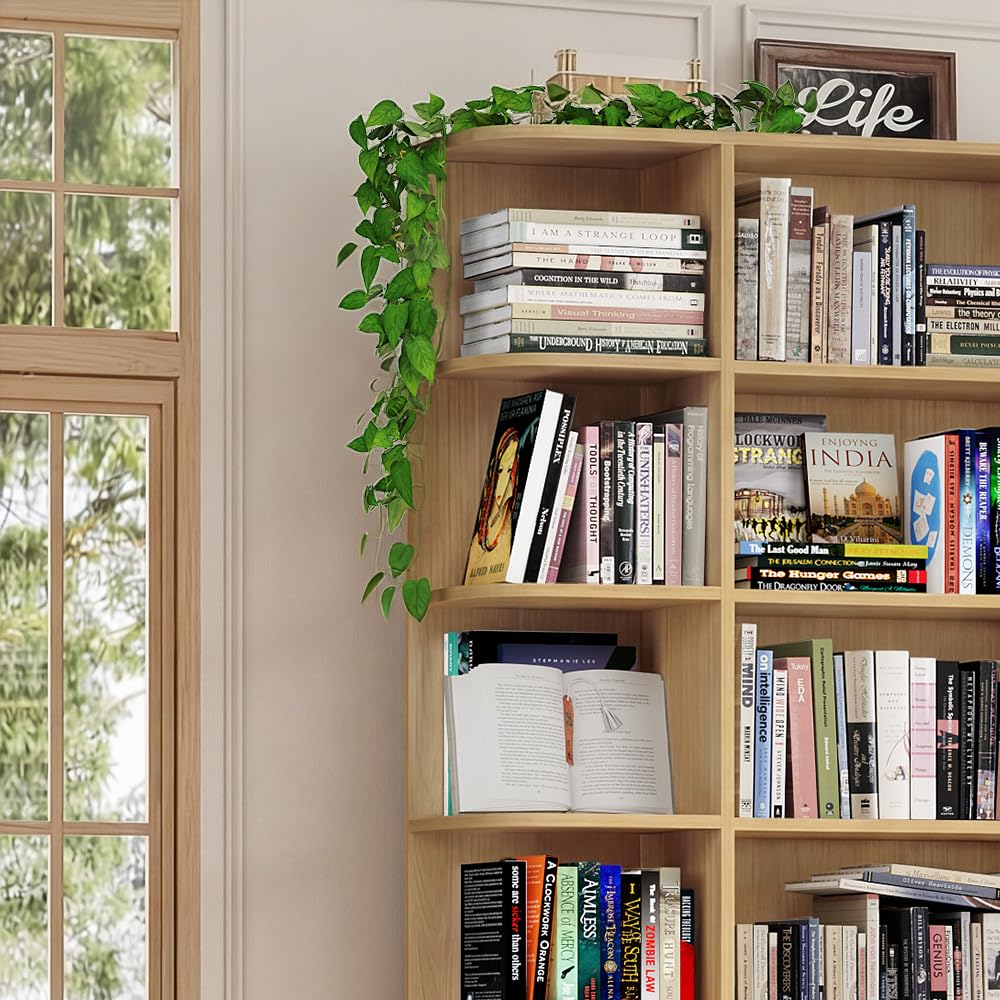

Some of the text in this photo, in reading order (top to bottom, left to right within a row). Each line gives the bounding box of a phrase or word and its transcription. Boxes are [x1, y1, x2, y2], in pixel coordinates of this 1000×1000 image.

[795, 78, 924, 138] Life
[539, 229, 560, 237] AM
[564, 229, 572, 238] A
[577, 230, 635, 240] STRANGE
[642, 232, 678, 242] LOOP
[536, 256, 589, 266] THE HAND
[534, 274, 619, 285] COGNITION IN THE WILD
[814, 262, 822, 285] Faraday
[933, 278, 978, 286] RELATIVITY
[557, 308, 589, 317] Visual
[592, 309, 635, 319] Thinking
[958, 308, 970, 317] the
[972, 309, 995, 319] theory
[931, 321, 943, 329] THE
[946, 322, 980, 331] ELECTRON
[539, 336, 593, 352] UNDERGROUND
[821, 438, 878, 447] ENJOYNG
[589, 444, 597, 475] TOOLS
[811, 449, 894, 467] INDIA
[686, 425, 695, 530] Programming Languages
[979, 442, 987, 520] BEWARE THE REAPER
[601, 460, 611, 522] Bootstrapping
[749, 544, 829, 555] The Last Good Man
[961, 527, 974, 589] DEMONS
[815, 558, 858, 566] CONNECTION
[759, 569, 891, 580] The Hunger Games
[773, 581, 819, 590] DRAGONFLY
[757, 655, 771, 743] on intelligence
[775, 720, 785, 738] OPEN
[512, 866, 520, 888] some
[561, 874, 574, 914] ABSENCE
[512, 906, 520, 932] sicker
[580, 878, 598, 939] AIMLESS
[536, 861, 557, 982] A CLOCKWORK ORANGE
[512, 934, 520, 953] than
[561, 930, 574, 963] MERCY
[646, 925, 655, 993] ZOMBIE LAW
[664, 942, 674, 978] HUNT
[933, 933, 942, 978] GENIUS
[512, 955, 520, 981] others
